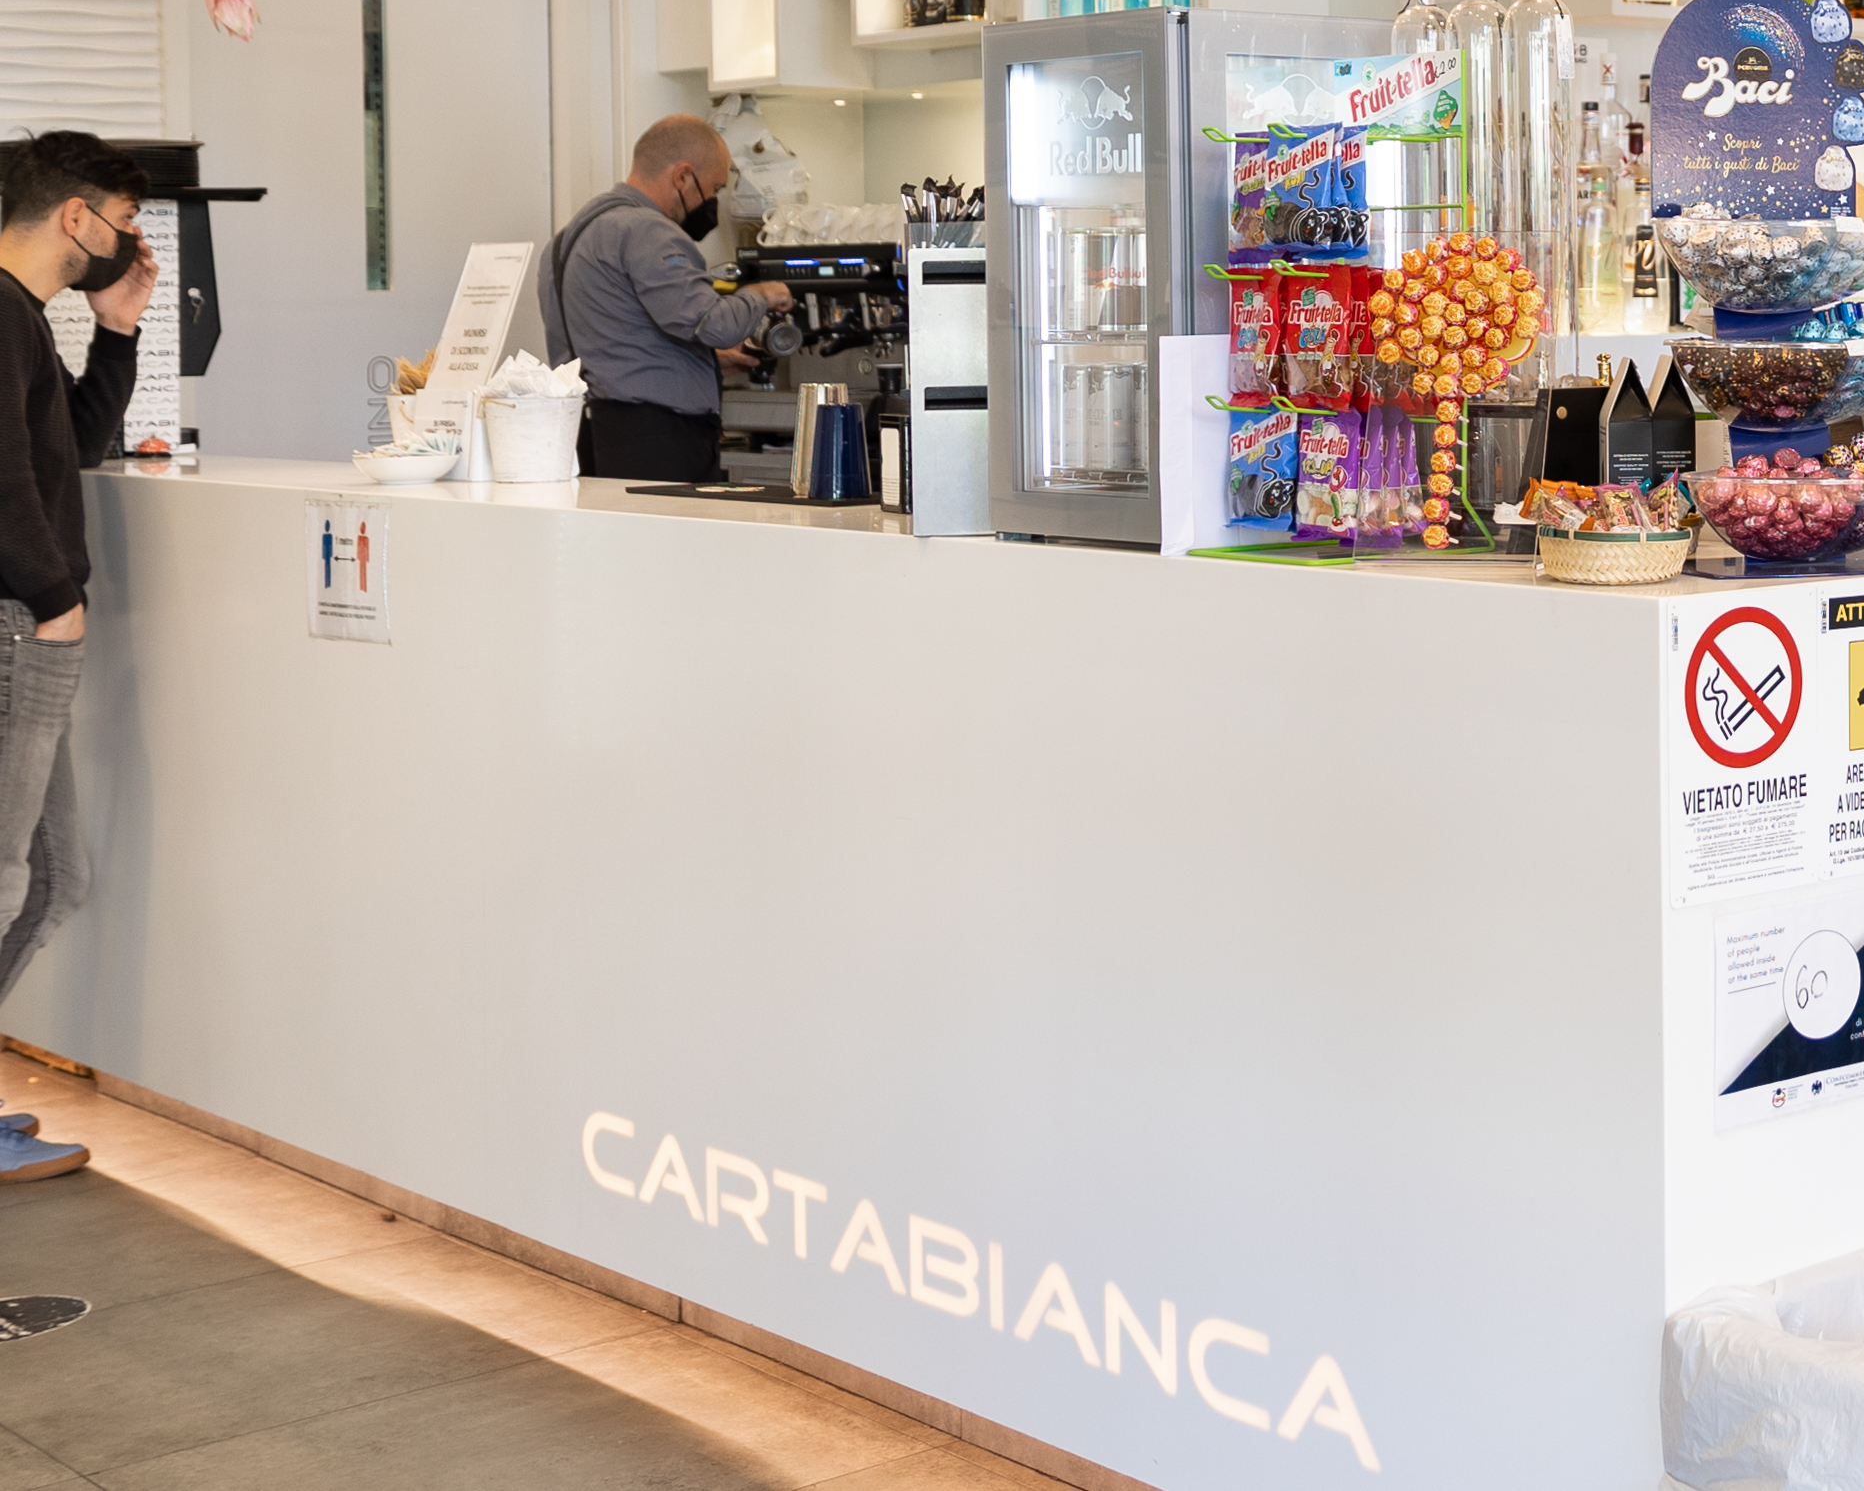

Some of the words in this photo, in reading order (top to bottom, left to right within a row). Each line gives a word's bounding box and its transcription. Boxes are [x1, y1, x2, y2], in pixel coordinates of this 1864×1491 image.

[1349, 57, 1435, 123] Fruit-tella
[1682, 56, 1793, 118] Baci
[1050, 135, 1092, 175] Red
[1096, 133, 1142, 174] Bull
[1723, 134, 1762, 155] Scopri
[1268, 140, 1327, 182] Fruit-tella
[1683, 156, 1712, 169] tutti
[1715, 158, 1720, 169] i
[1723, 157, 1753, 178] gusti
[1755, 156, 1768, 169] di
[1772, 156, 1798, 173] Baci
[1230, 415, 1291, 456] Fruit-tella
[1300, 432, 1349, 457] Fruit-tella
[1683, 784, 1742, 815] VIETATO
[1748, 774, 1807, 805] FUMARE
[1837, 795, 1843, 814] A
[1829, 823, 1847, 843] PER
[1727, 932, 1759, 945] Maximum
[1761, 926, 1785, 938] number
[1728, 949, 1734, 958] of
[1737, 944, 1760, 957] people
[1728, 960, 1754, 971] allowed
[1756, 955, 1776, 965] inside
[1728, 977, 1735, 985] at
[1737, 973, 1747, 981] the
[1750, 971, 1767, 979] same
[1770, 966, 1784, 975] time
[1795, 964, 1828, 1009] 60
[1856, 1018, 1862, 1027] di
[582, 1111, 1382, 1473] CARTABIANCA
